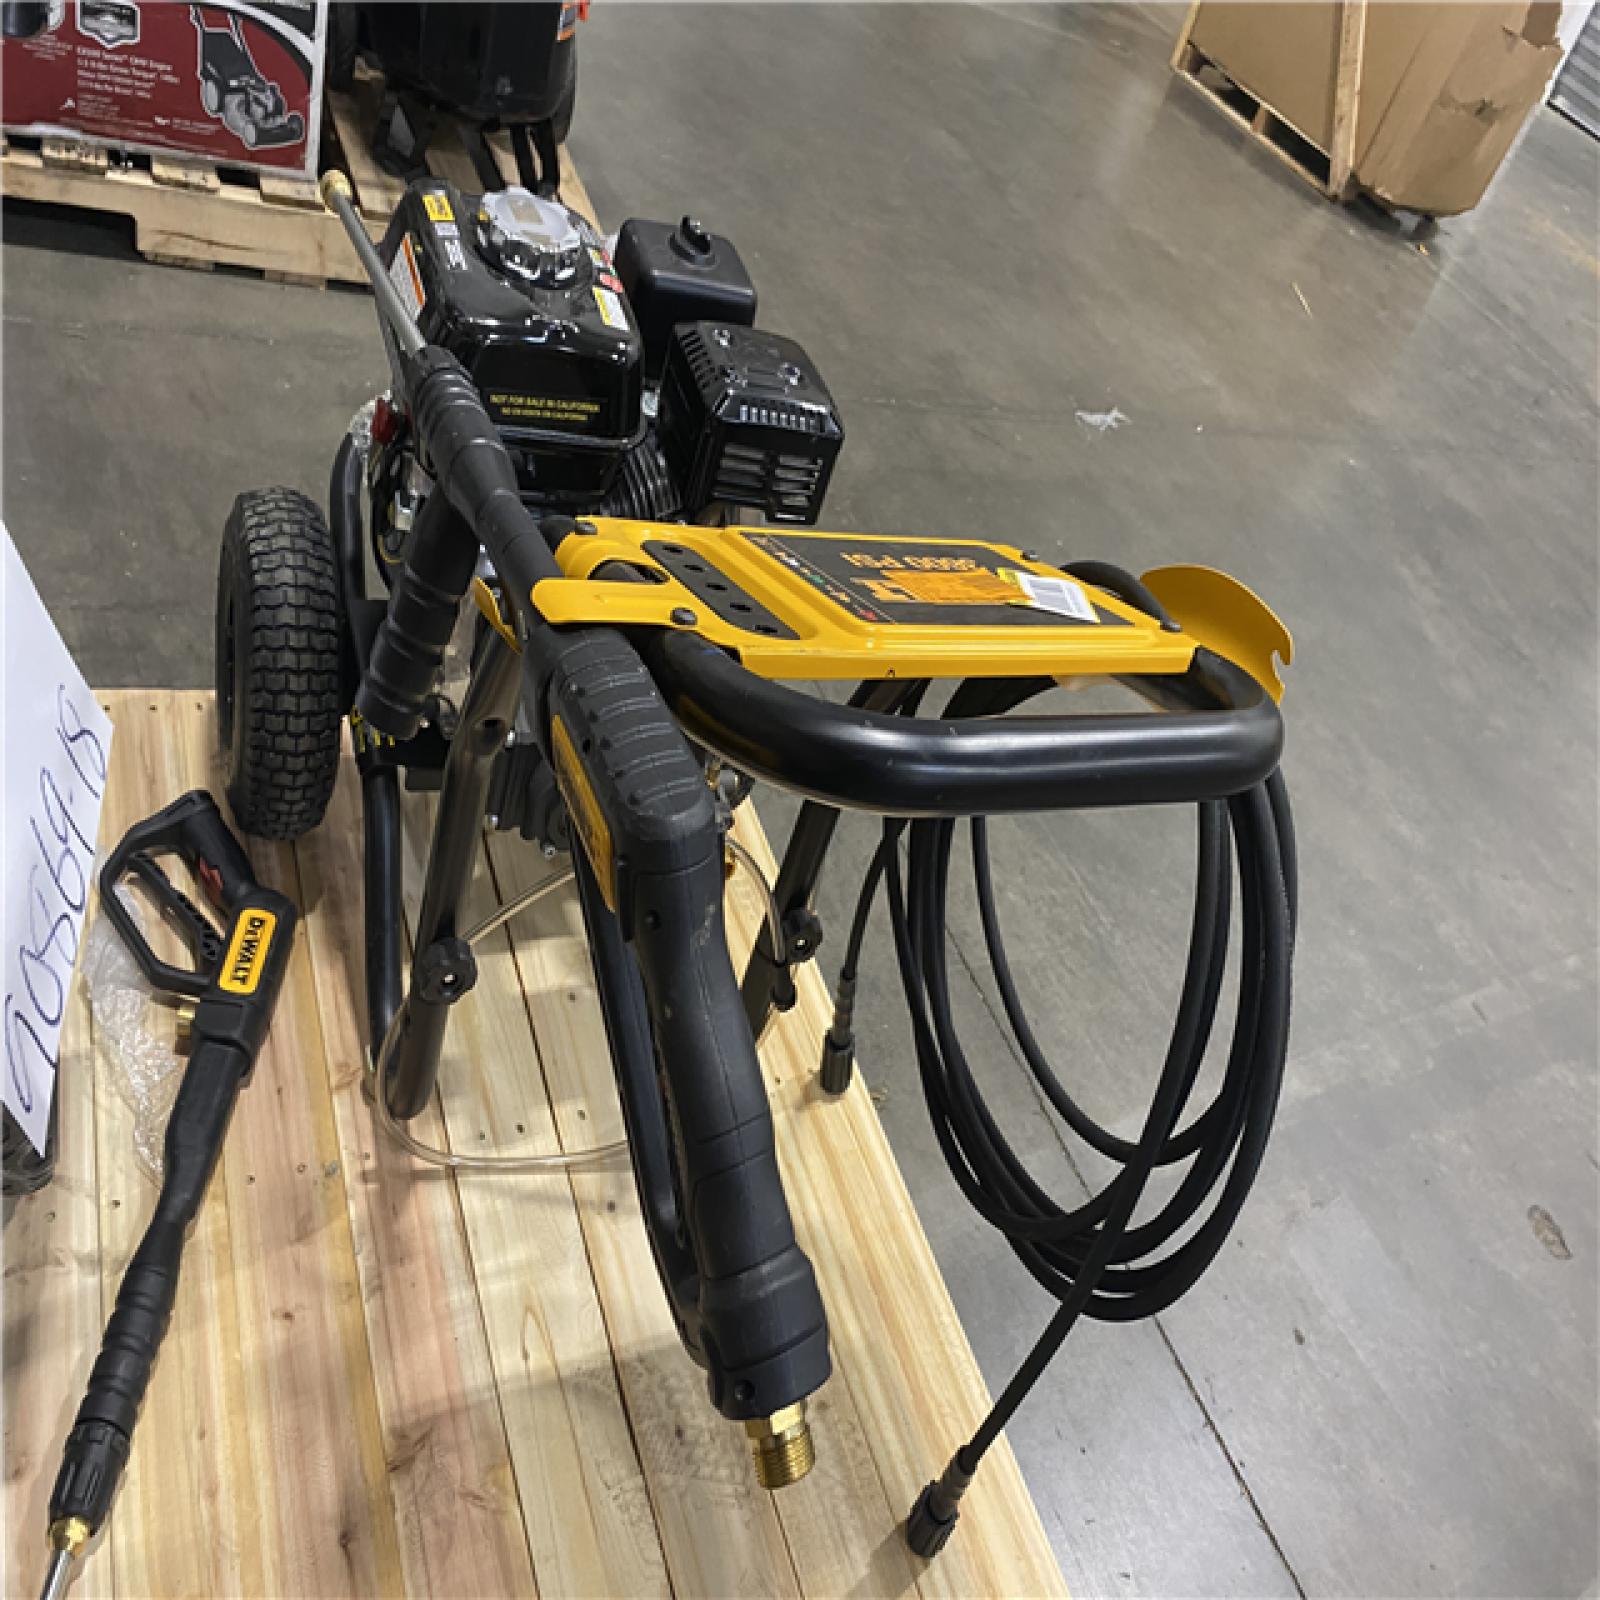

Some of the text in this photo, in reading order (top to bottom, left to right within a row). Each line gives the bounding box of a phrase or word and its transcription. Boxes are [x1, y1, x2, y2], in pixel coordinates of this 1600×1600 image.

[490, 395, 508, 404] NOT
[509, 395, 524, 405] FOR
[557, 400, 600, 412] CALIFORNIA
[231, 916, 266, 985] DEWALT
